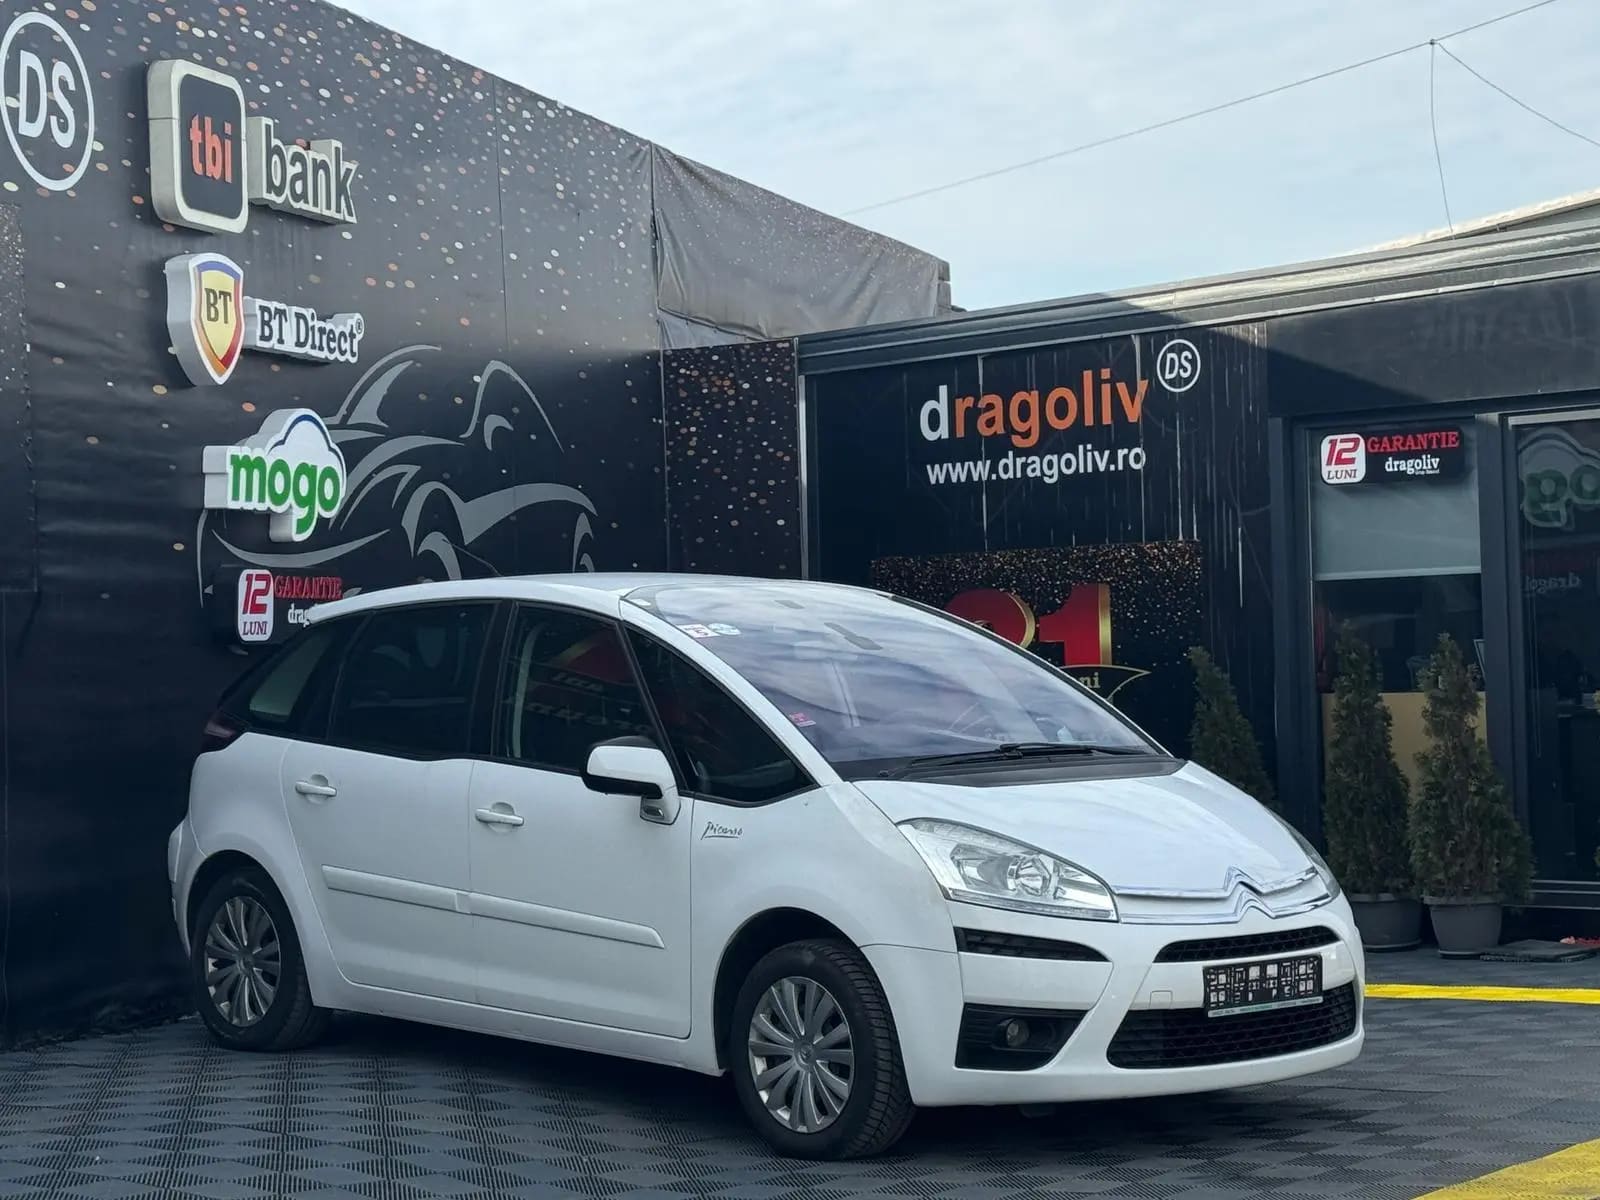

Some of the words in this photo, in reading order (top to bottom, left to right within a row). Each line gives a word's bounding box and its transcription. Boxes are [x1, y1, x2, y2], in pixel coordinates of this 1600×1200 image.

[18, 50, 76, 148] DS
[190, 112, 233, 184] tbi
[265, 123, 356, 223] bank
[204, 287, 232, 324] BT
[259, 305, 288, 345] BT
[1165, 350, 1192, 380] DS
[920, 368, 1149, 447] dragoliv
[926, 443, 1147, 484] www.dragoliv.ro
[1326, 437, 1361, 466] 12
[1367, 431, 1460, 453] GARANTIE
[1384, 454, 1440, 475] dragoliv
[230, 453, 341, 534] mogo
[1327, 468, 1357, 480] LUNI
[242, 573, 271, 615] 12
[274, 575, 343, 600] GARANTIE
[243, 621, 268, 636] LUNI
